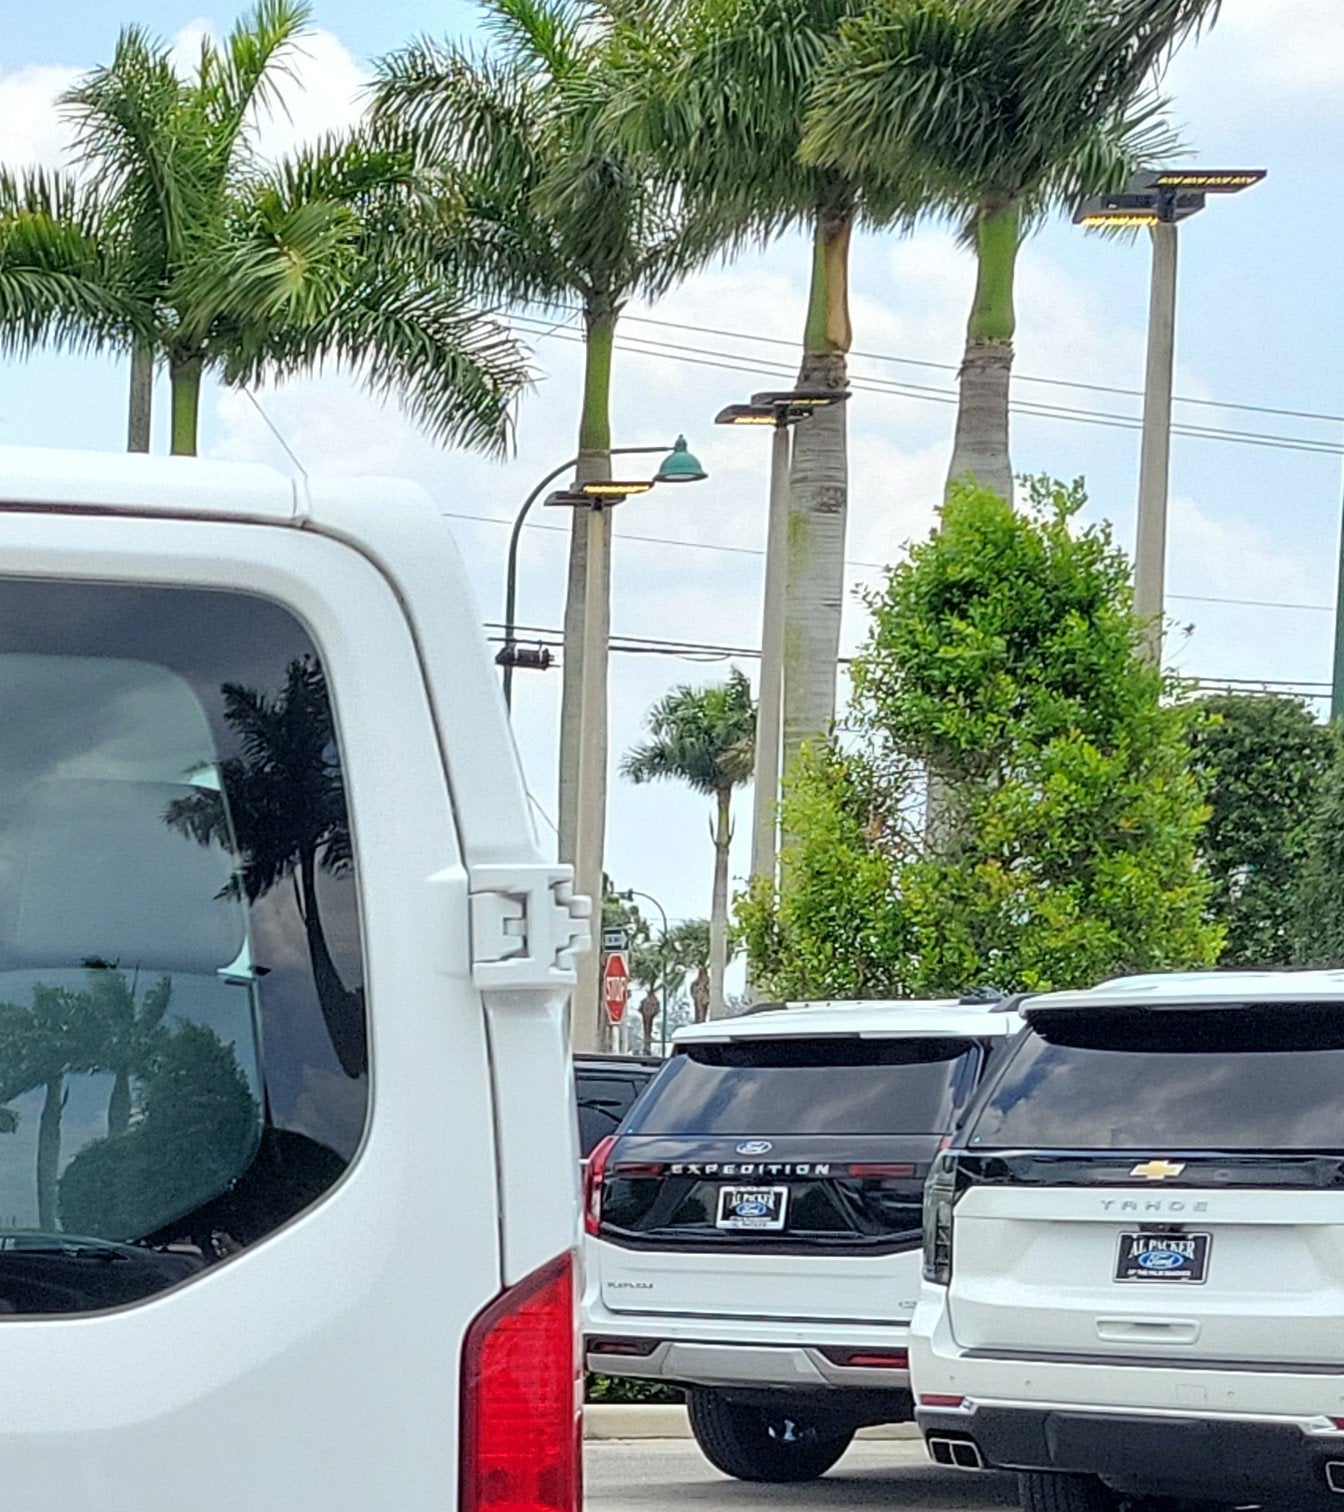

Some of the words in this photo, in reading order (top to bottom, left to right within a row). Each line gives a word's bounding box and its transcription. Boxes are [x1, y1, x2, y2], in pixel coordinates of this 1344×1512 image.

[670, 1164, 830, 1175] EXPEDITION
[1101, 1200, 1208, 1212] TAHOE
[1128, 1239, 1148, 1259] AL
[1148, 1239, 1195, 1259] PACKER
